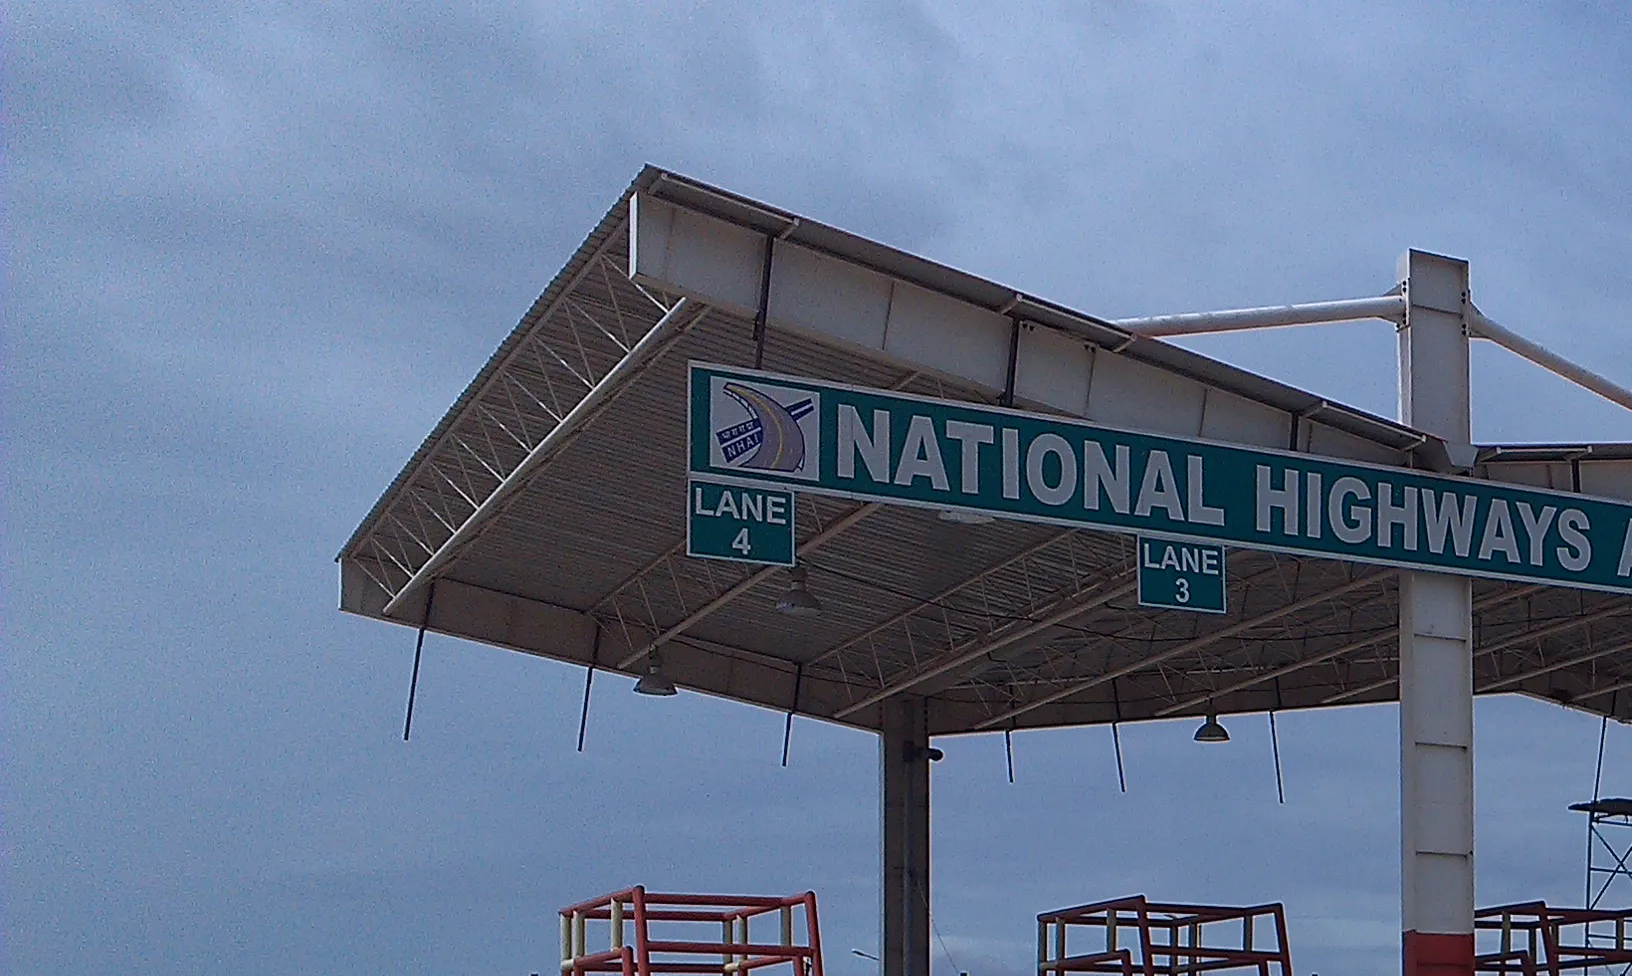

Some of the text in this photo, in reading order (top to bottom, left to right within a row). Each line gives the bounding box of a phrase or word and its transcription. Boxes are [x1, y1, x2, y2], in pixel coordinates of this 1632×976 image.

[726, 434, 760, 458] NHAI
[837, 403, 1225, 527] NATIONAL
[1256, 464, 1592, 572] HIGHWAYS
[695, 487, 786, 525] LANE
[731, 527, 752, 556] 4
[1143, 542, 1219, 576] LANE
[1175, 577, 1190, 603] 3
